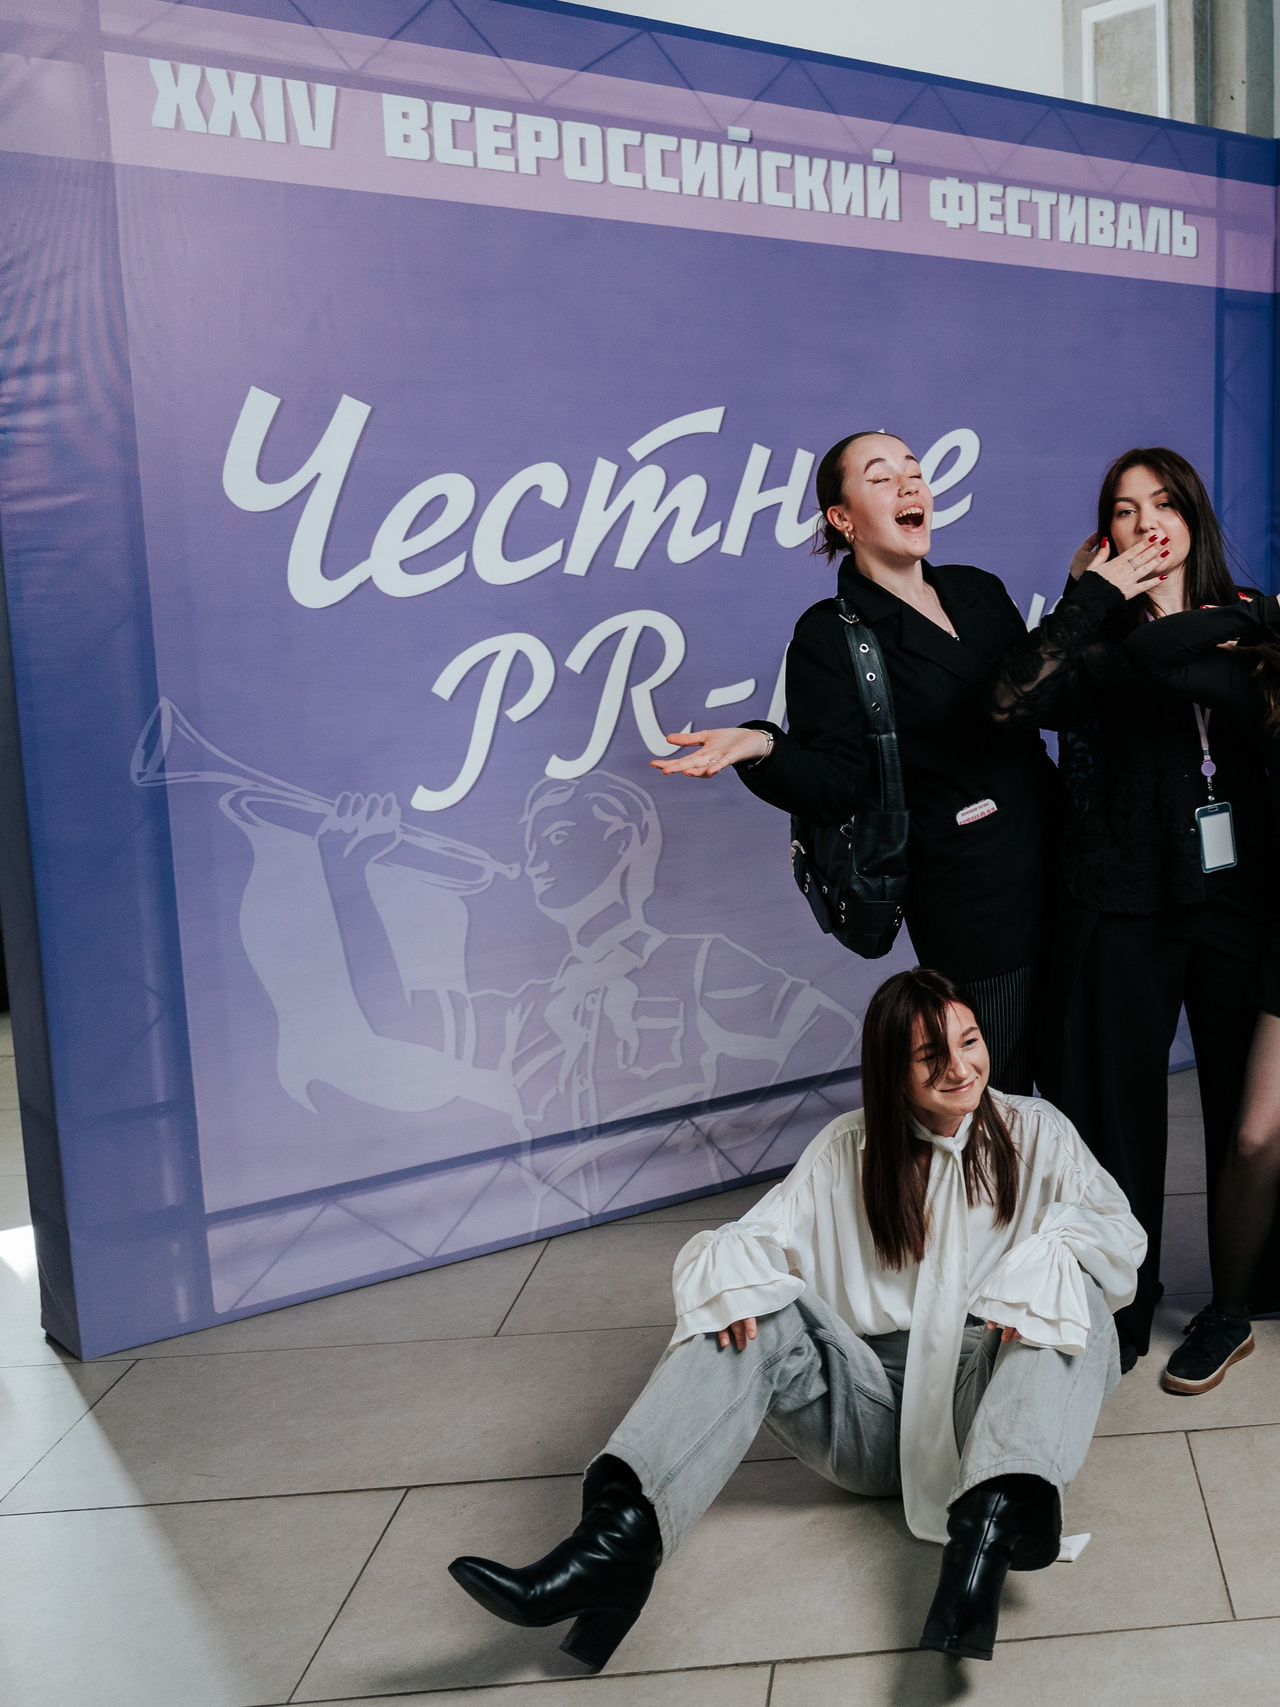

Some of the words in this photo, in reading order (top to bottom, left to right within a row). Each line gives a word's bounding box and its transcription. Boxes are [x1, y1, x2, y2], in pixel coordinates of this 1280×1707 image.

[149, 58, 337, 149] XXIV
[382, 93, 900, 221] ВСЕРОССИЙСКИЙ
[929, 176, 1198, 258] ФЕСТИВАЛЬ
[222, 386, 982, 608] Честне
